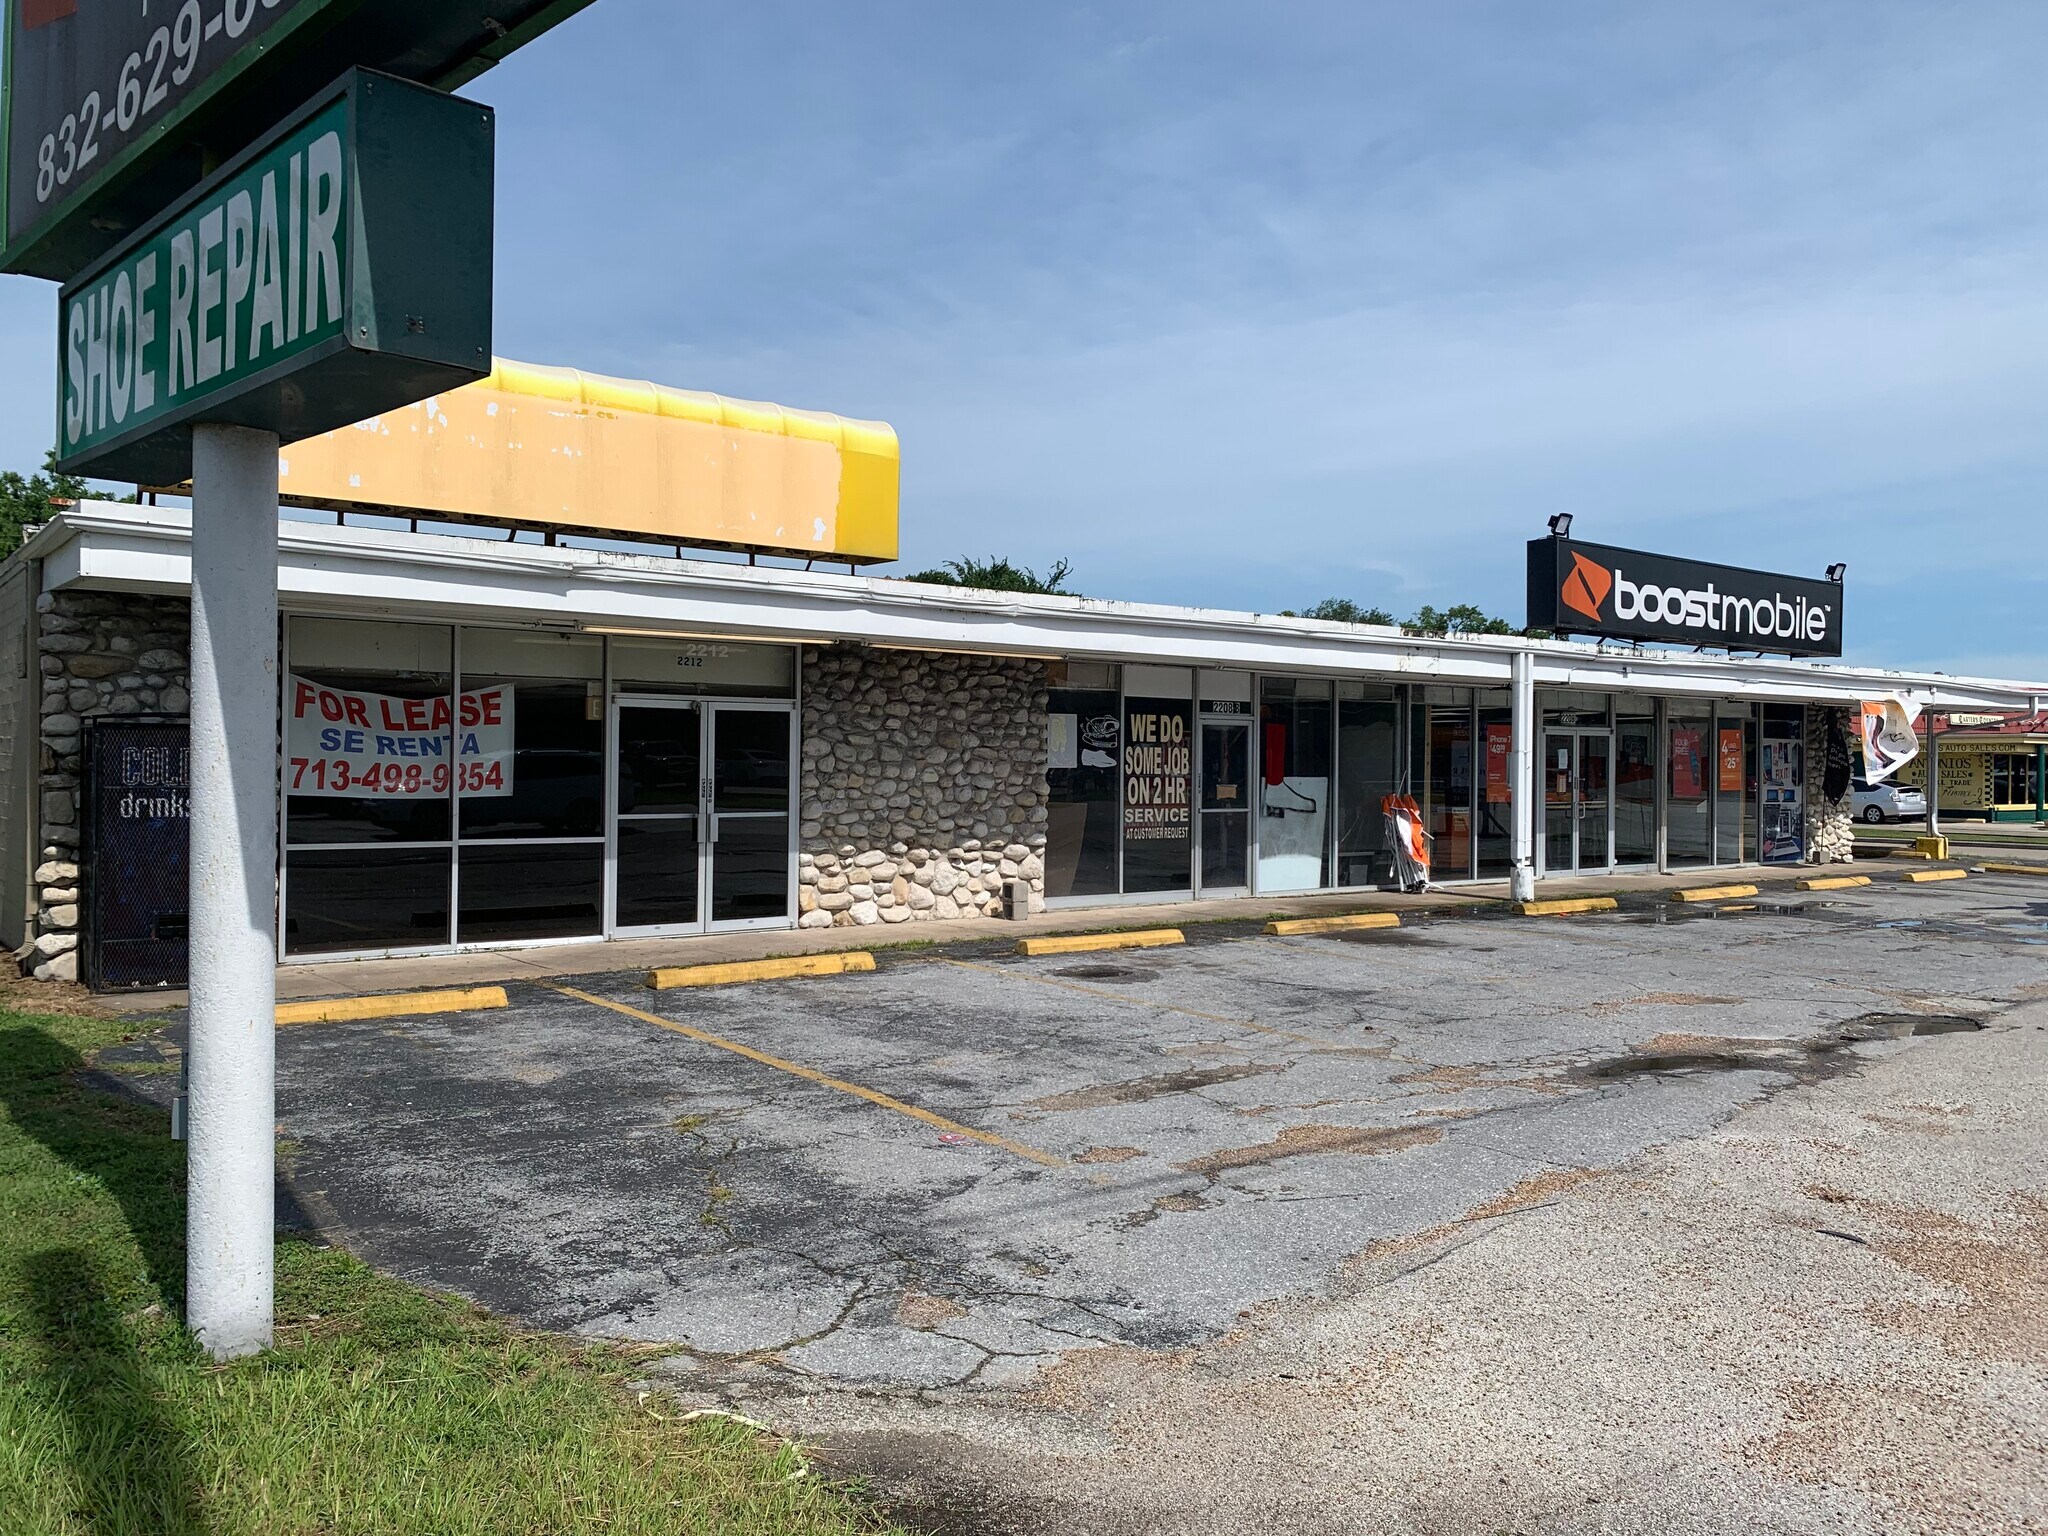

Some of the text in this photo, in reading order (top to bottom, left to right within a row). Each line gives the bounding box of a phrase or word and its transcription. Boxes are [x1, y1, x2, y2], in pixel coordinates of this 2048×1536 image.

[66, 131, 342, 445] SHOE REPAIR
[677, 656, 703, 667] 2212
[294, 681, 502, 731] FOR LEASE
[320, 728, 364, 753] SE
[1131, 713, 1184, 743] WE DO
[1125, 746, 1189, 775] SOME JOB
[1945, 744, 1966, 752] AUTO
[1941, 770, 1968, 779] SALES
[1127, 776, 1150, 805] ON
[1153, 777, 1162, 805] 2
[1165, 777, 1186, 804] HR
[1124, 807, 1189, 823] SERVICE
[1126, 826, 1189, 840] AT CUSTOMER REQUEST
